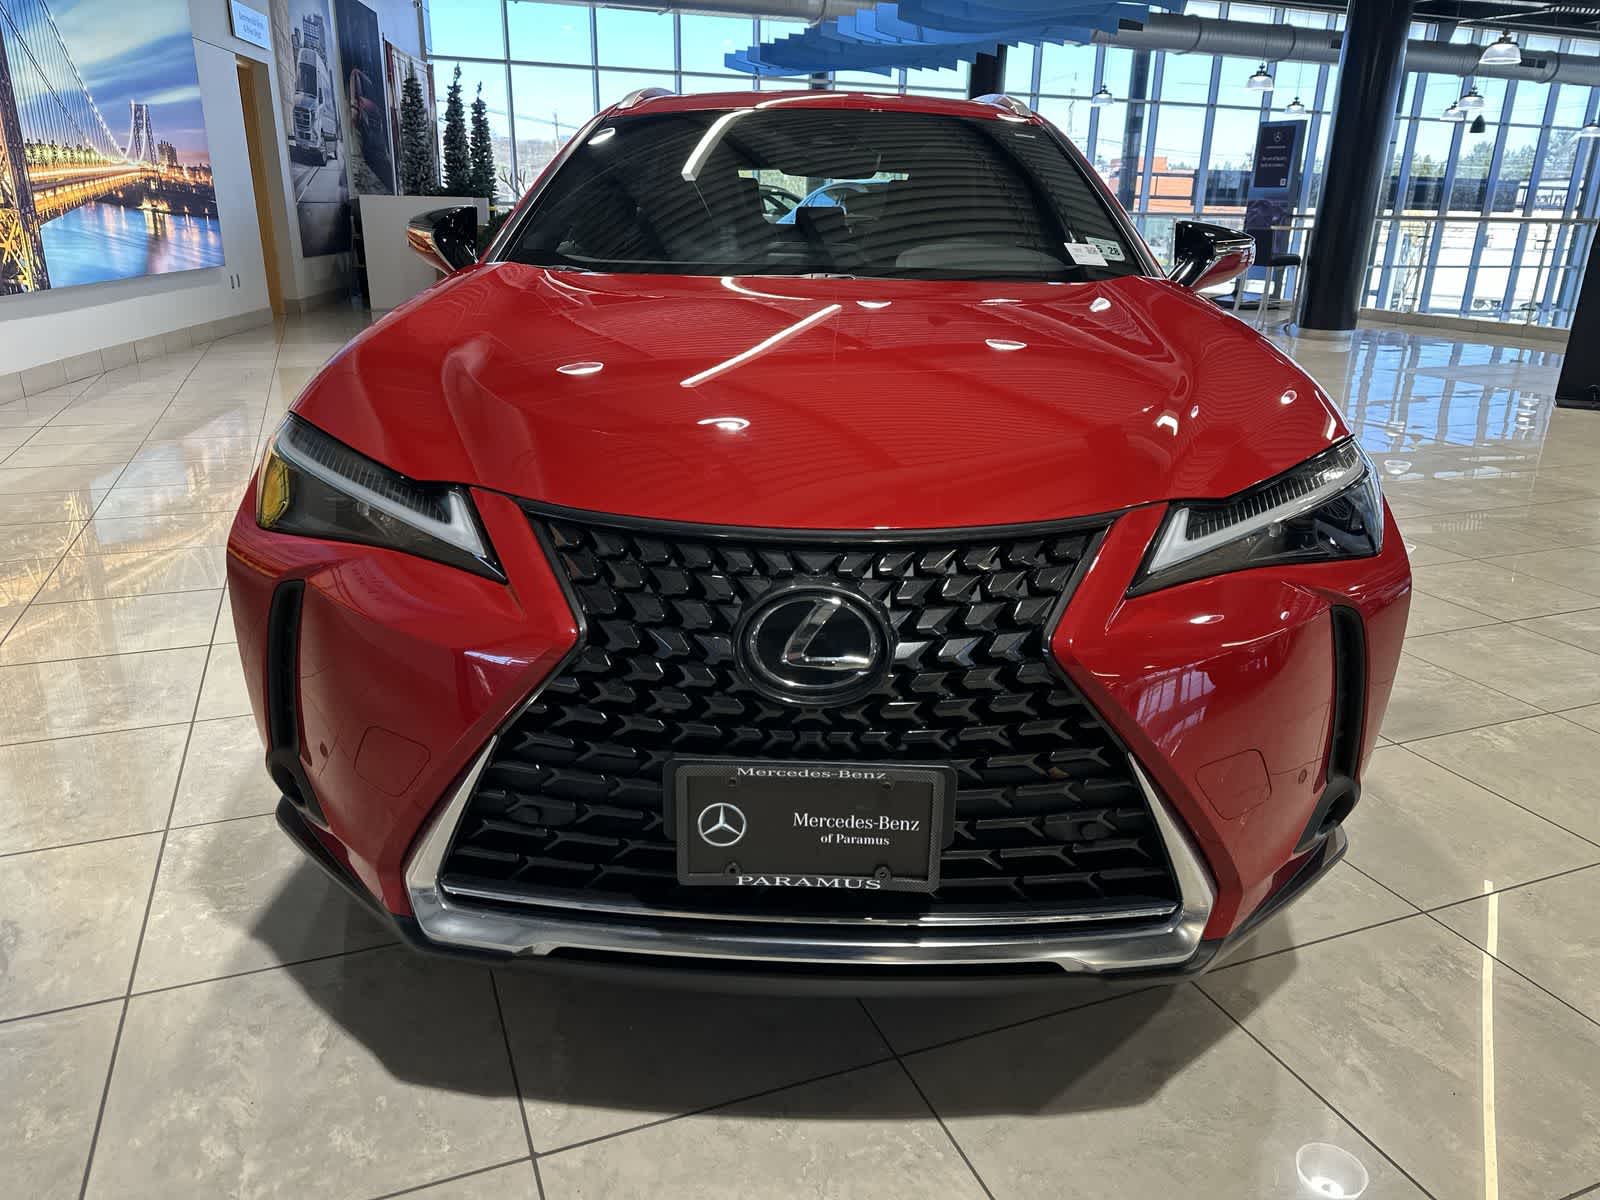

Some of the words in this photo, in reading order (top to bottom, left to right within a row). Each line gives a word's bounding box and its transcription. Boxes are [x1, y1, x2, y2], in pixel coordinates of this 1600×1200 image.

[737, 767, 887, 780] Mercedes-Benz
[792, 811, 920, 832] Mercedes-Benz
[820, 833, 834, 844] of
[836, 833, 890, 846] Paramus
[736, 875, 881, 890] PARAMUS
